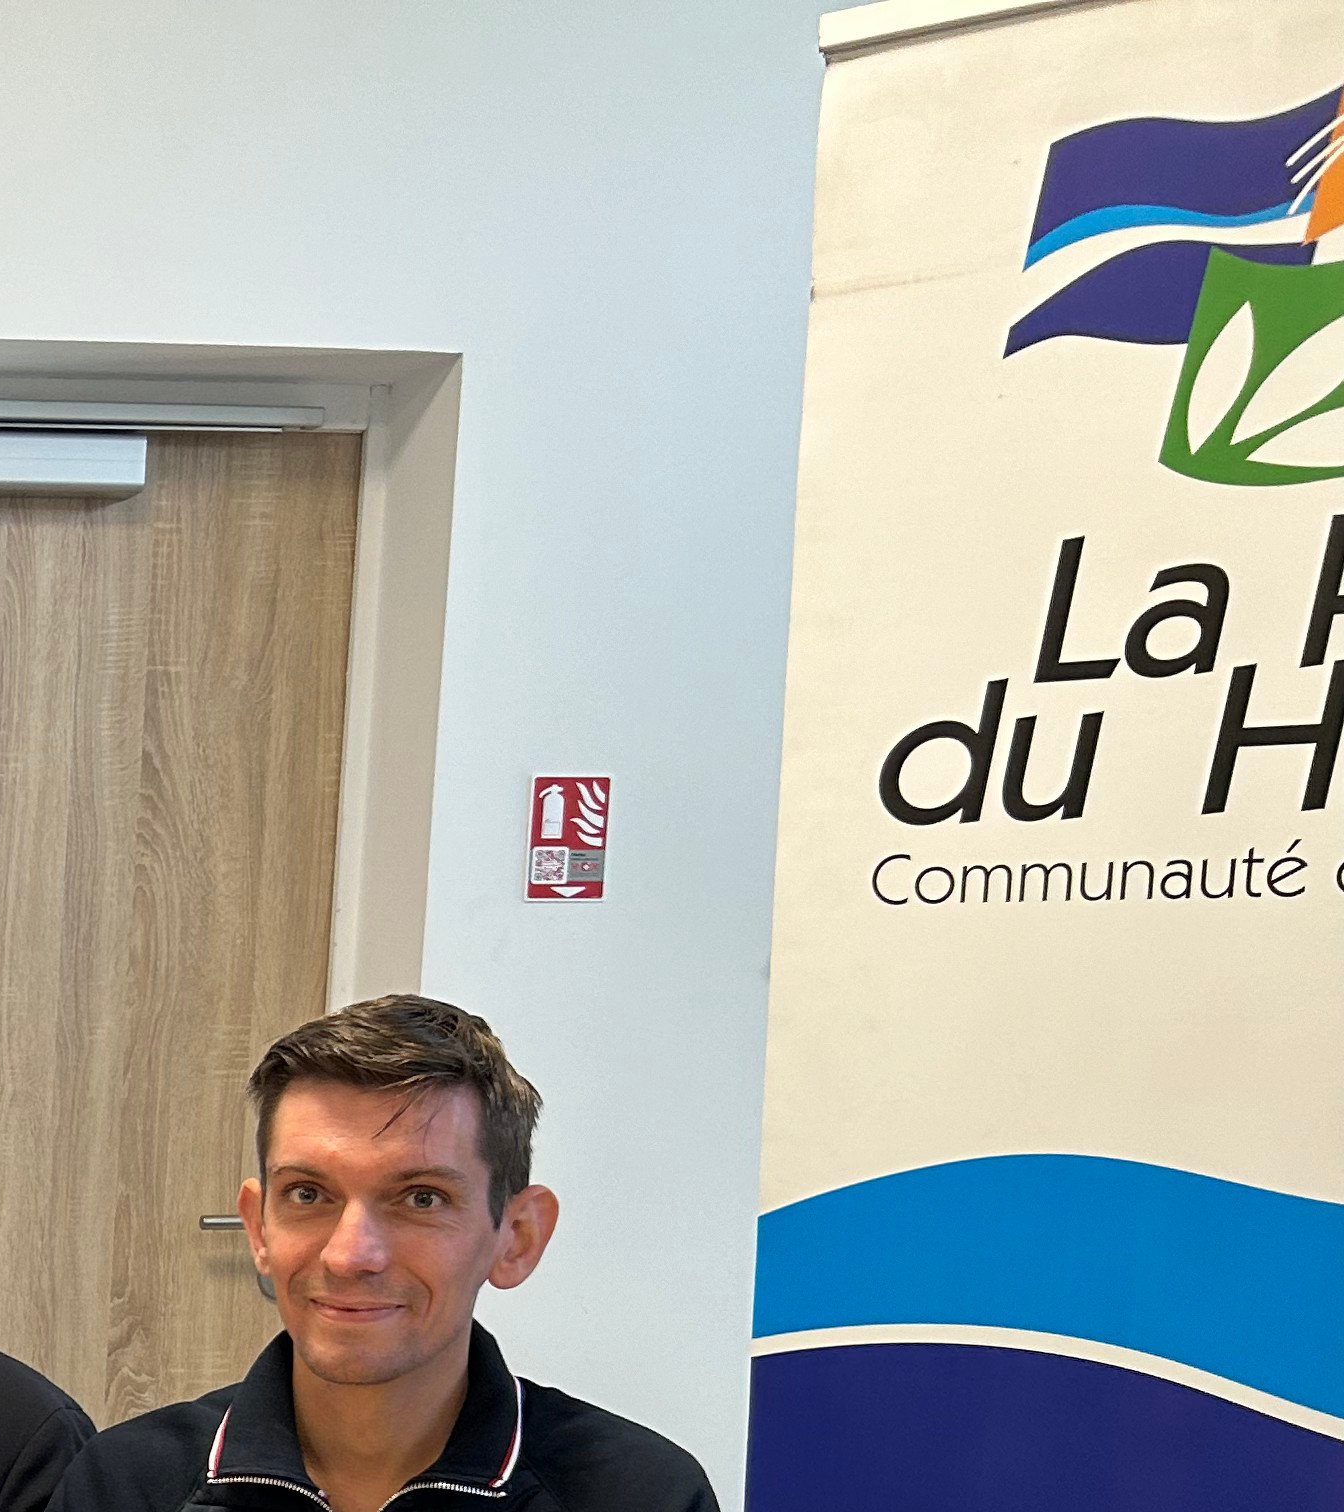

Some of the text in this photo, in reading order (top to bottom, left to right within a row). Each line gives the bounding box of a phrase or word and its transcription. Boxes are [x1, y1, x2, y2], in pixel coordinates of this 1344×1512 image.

[1033, 535, 1230, 684] La
[878, 677, 1105, 826] du
[872, 838, 1309, 906] Communauté
